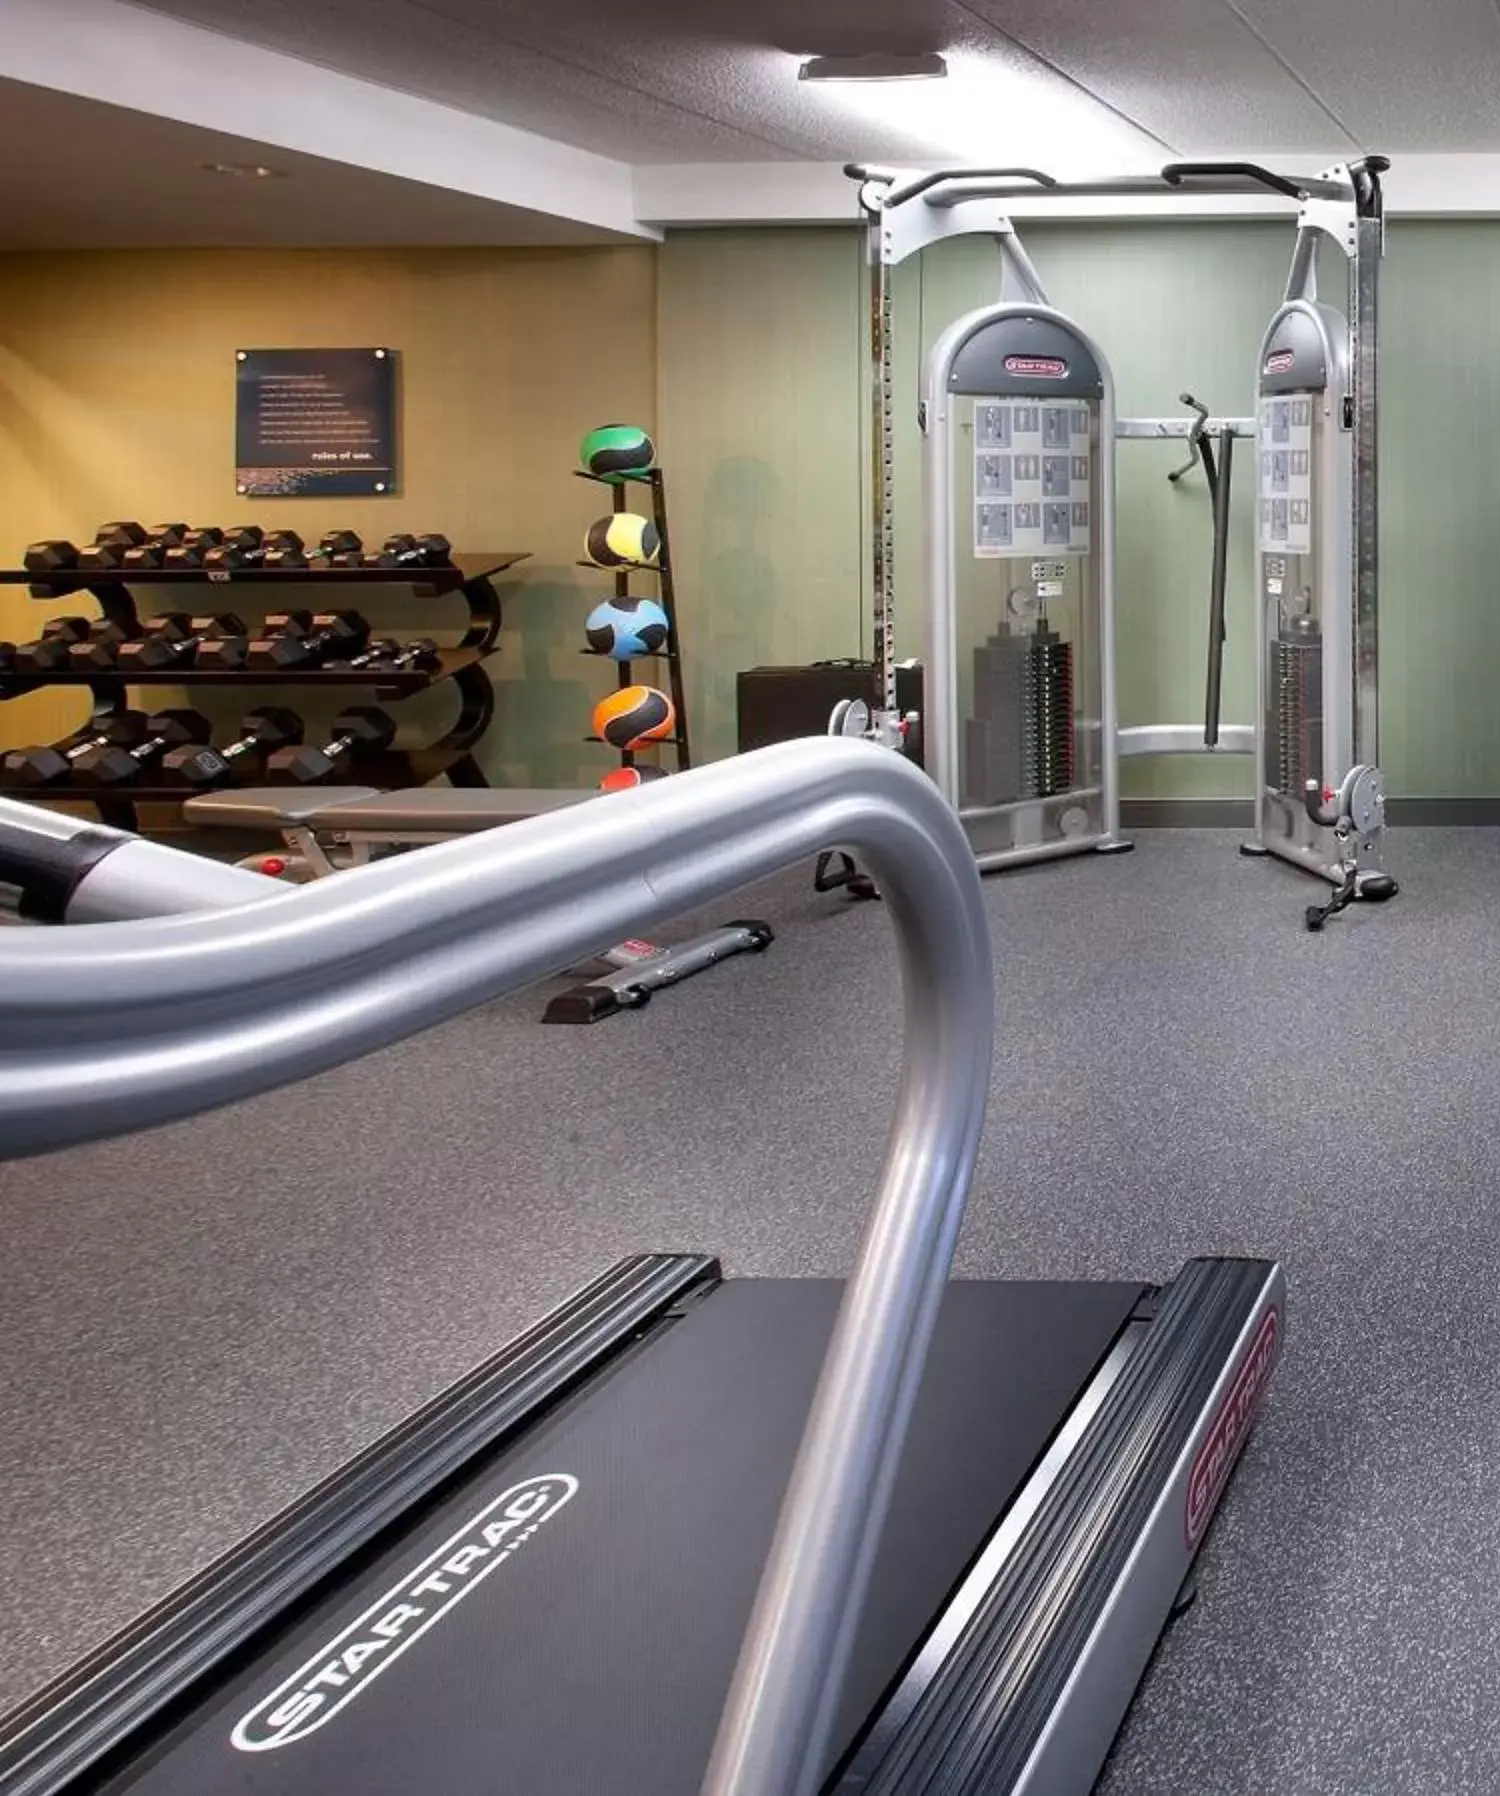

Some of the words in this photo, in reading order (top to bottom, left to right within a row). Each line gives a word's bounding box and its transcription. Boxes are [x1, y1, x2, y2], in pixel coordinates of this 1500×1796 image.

[339, 451, 351, 460] of
[265, 1602, 427, 1730] STAR
[408, 1490, 550, 1598] TRAC
